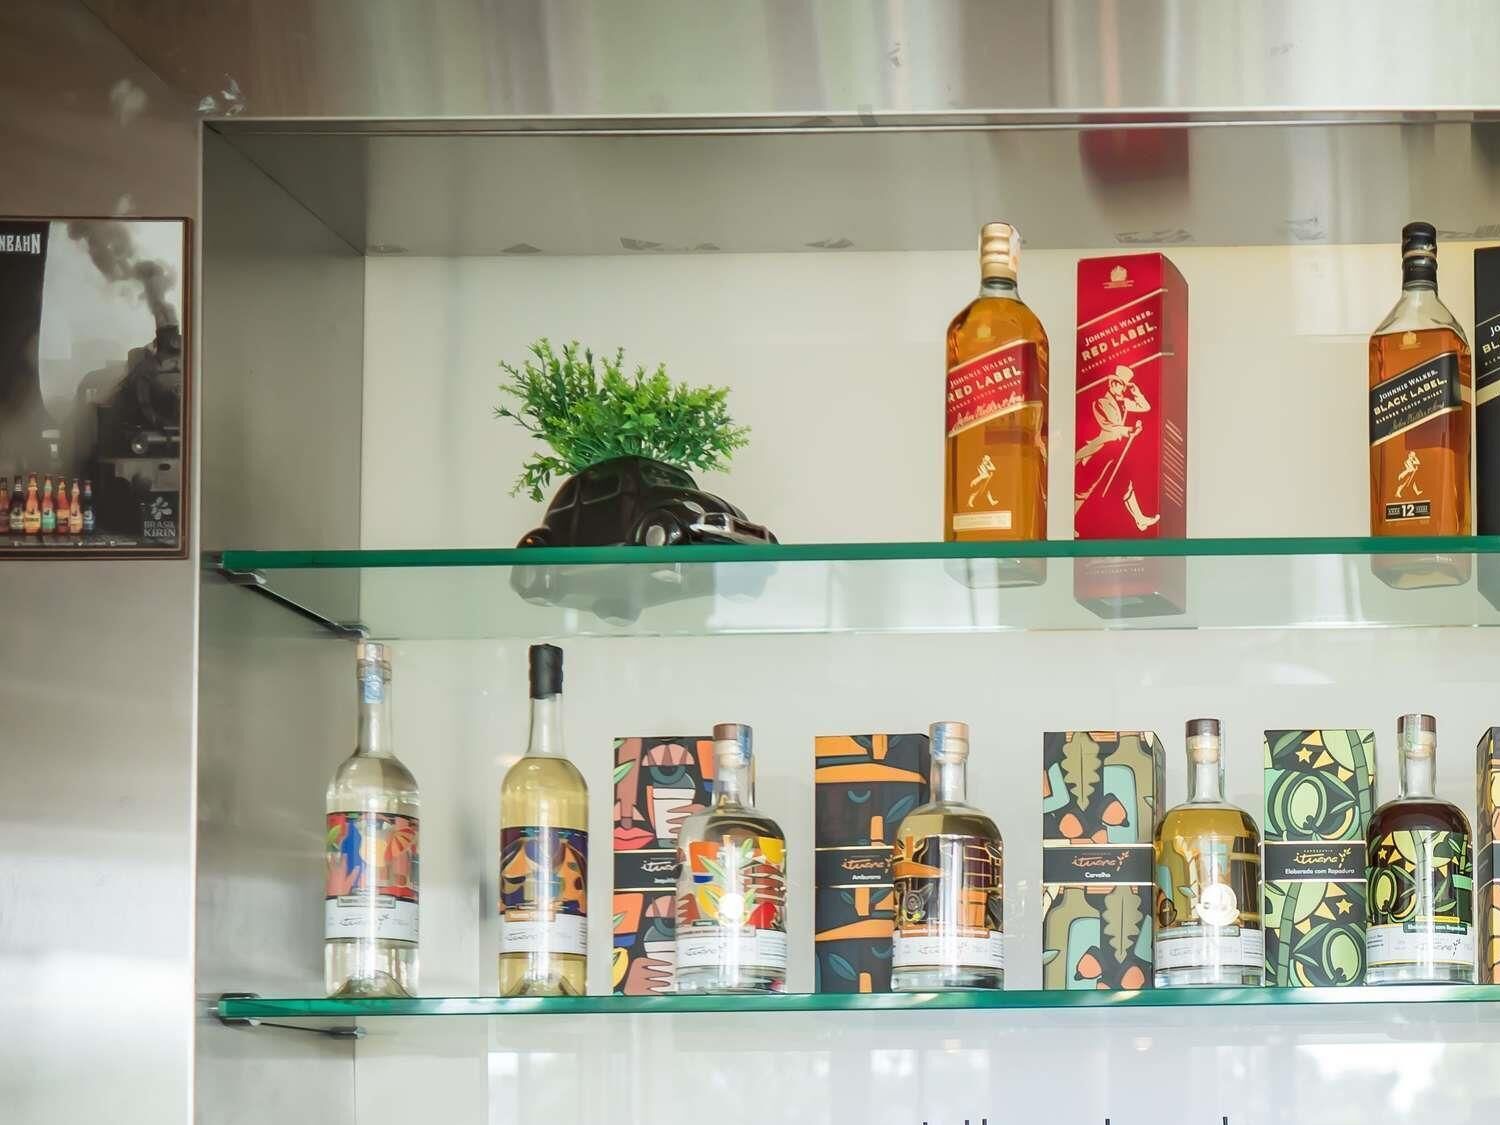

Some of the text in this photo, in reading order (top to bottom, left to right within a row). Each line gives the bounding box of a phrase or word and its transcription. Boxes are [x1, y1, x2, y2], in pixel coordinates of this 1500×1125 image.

[1085, 325, 1119, 346] JOHNNIE
[1081, 342, 1108, 361] RED
[948, 385, 973, 402] RED
[975, 366, 1023, 389] LABEL
[1379, 383, 1408, 402] JOHNNIE
[1374, 394, 1408, 415] BLACK
[1402, 504, 1415, 517] 12
